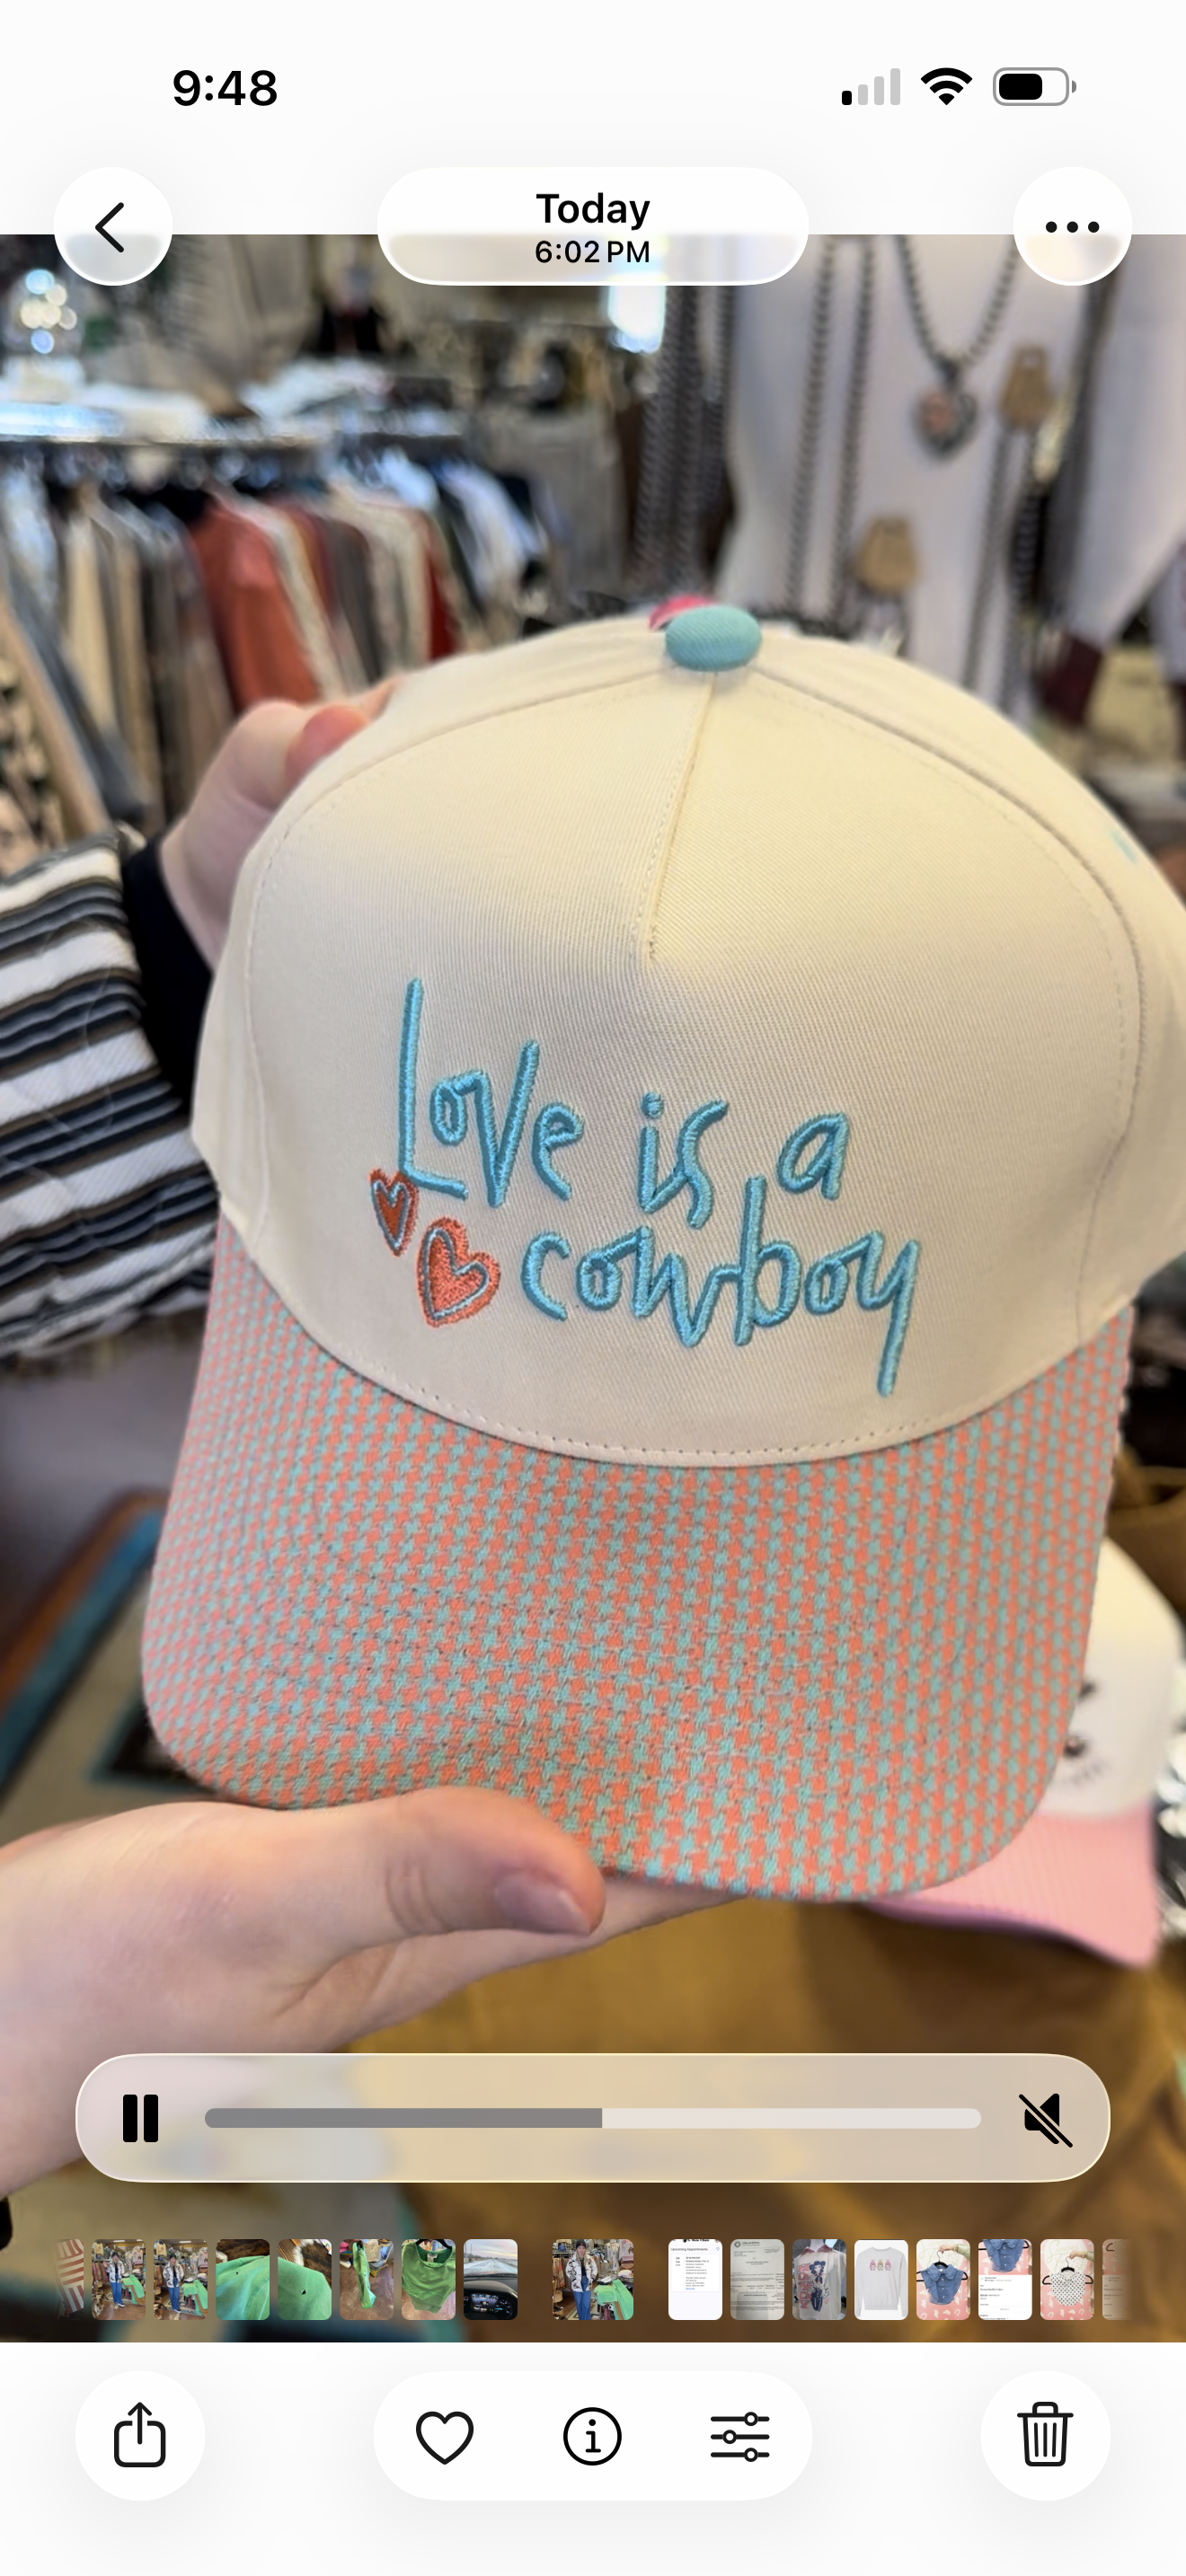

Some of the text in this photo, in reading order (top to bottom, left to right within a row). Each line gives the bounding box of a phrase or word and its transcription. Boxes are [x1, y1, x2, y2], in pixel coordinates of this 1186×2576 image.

[397, 976, 850, 1229] Love is a
[520, 1175, 921, 1398] cowboy
